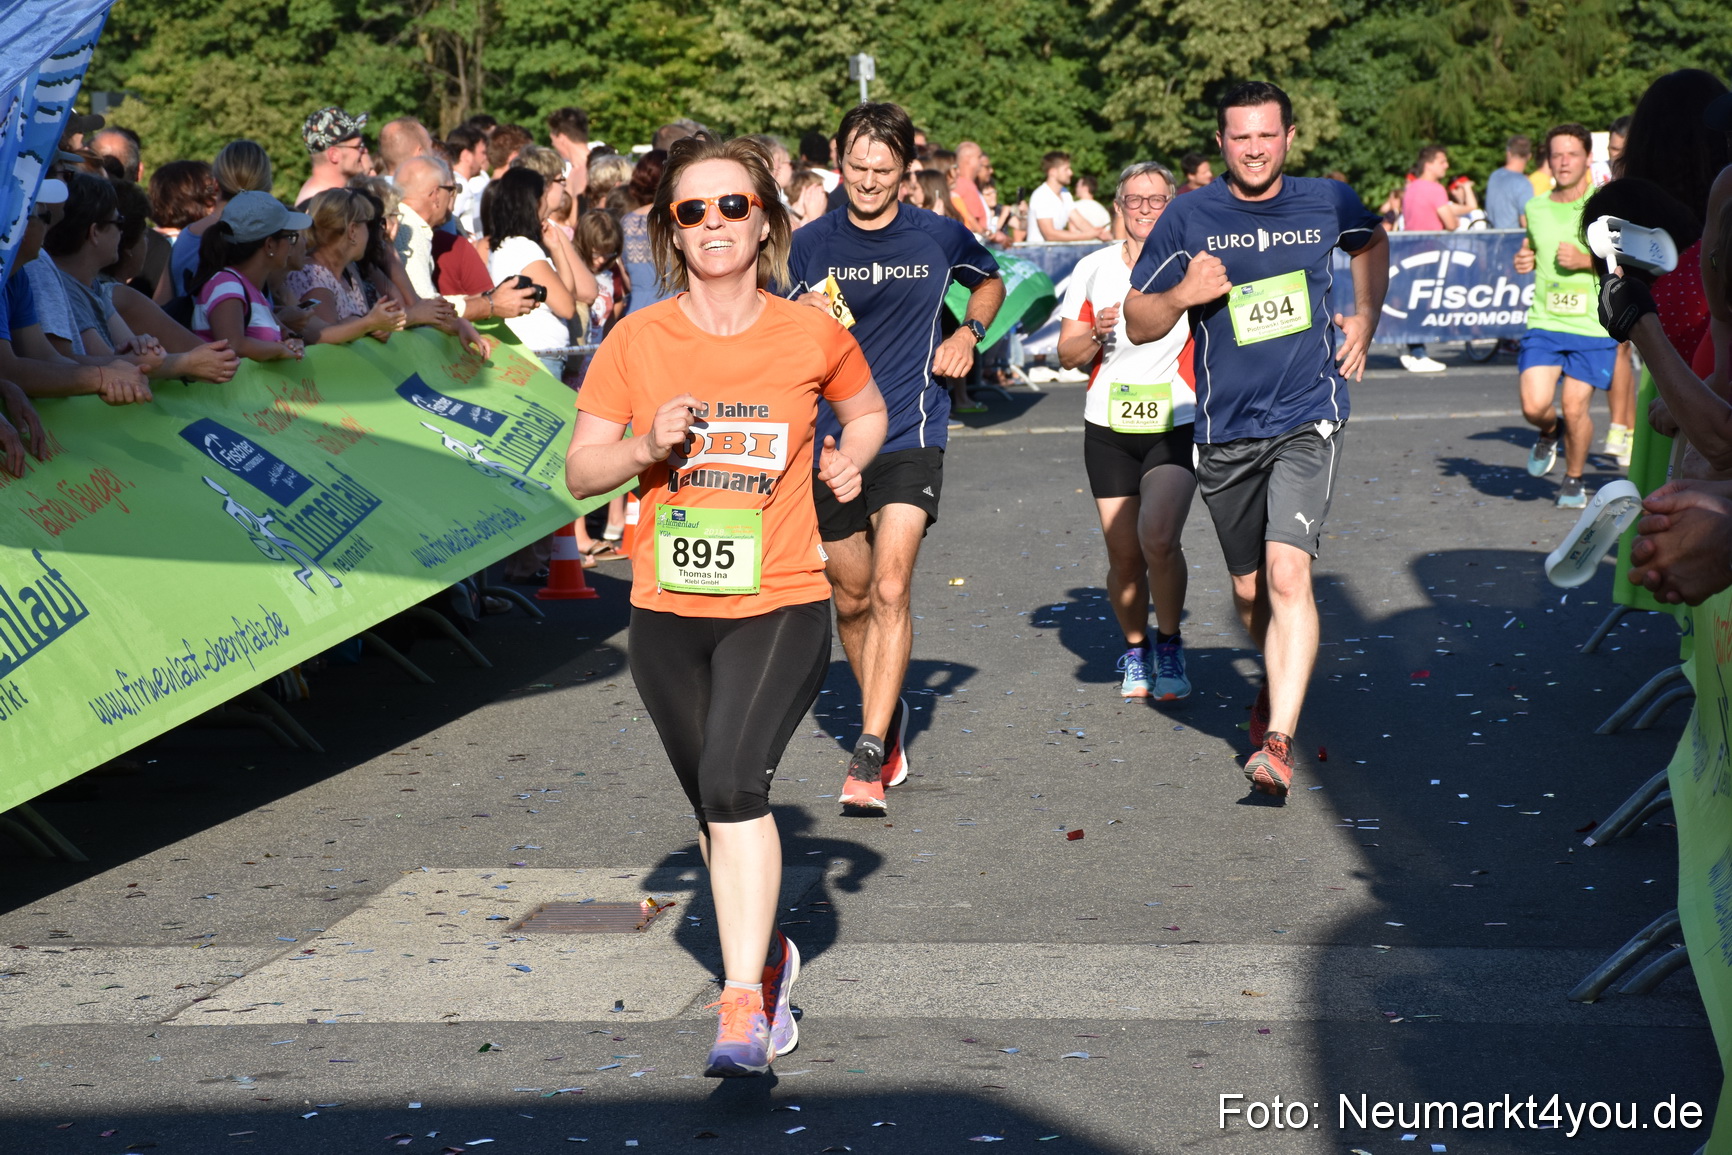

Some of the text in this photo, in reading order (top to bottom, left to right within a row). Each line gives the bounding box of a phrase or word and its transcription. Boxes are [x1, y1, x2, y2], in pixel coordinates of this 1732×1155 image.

[1206, 229, 1321, 252] EURO POLES
[828, 264, 929, 281] EURO POLES
[1249, 295, 1294, 324] 494
[1551, 293, 1579, 307] 345
[715, 402, 769, 418] Jahre
[1121, 401, 1158, 419] 248
[219, 440, 255, 467] Fischer
[671, 431, 779, 460] OBI
[267, 461, 383, 561] firmenlauf
[704, 527, 725, 536] 2018
[332, 533, 374, 577] neumarkt
[672, 536, 736, 570] 895
[678, 568, 728, 579] Thomas Ina
[701, 578, 720, 586] GmbH
